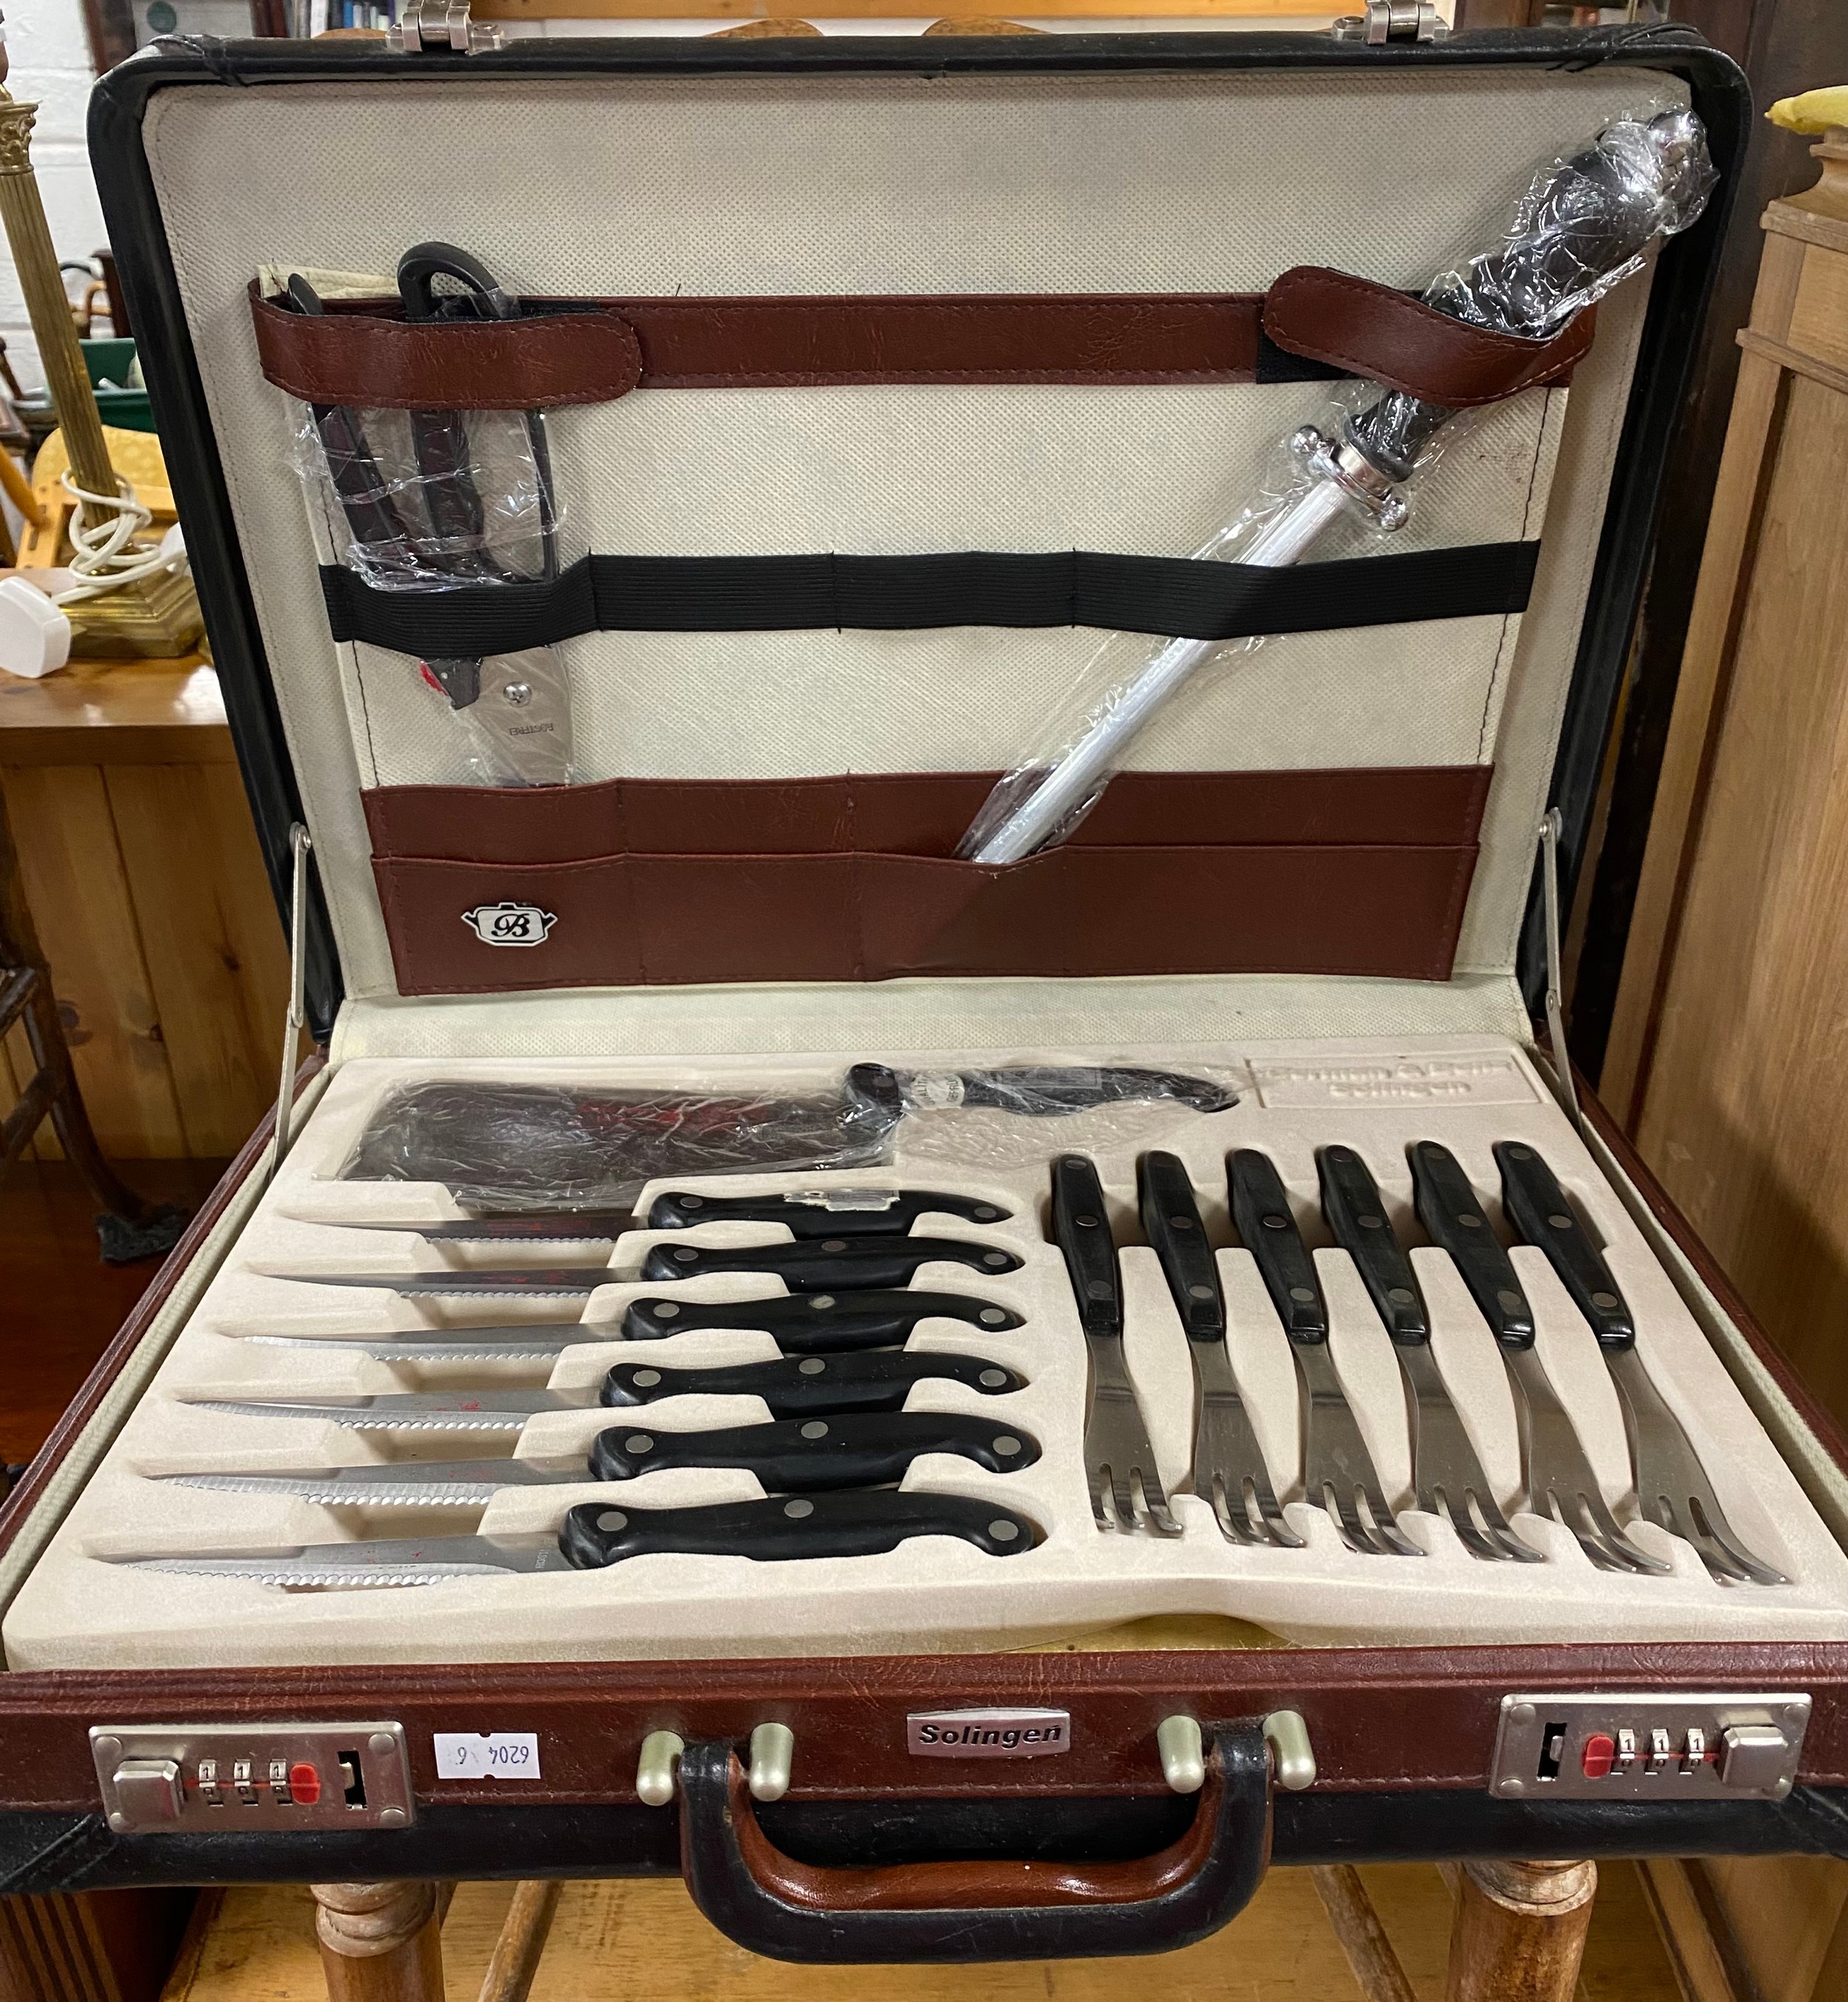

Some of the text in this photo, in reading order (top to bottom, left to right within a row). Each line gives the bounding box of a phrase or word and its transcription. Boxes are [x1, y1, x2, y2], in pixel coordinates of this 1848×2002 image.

[491, 913, 530, 937] B
[918, 1724, 1061, 1749] Solingen
[488, 1745, 529, 1765] 6204
